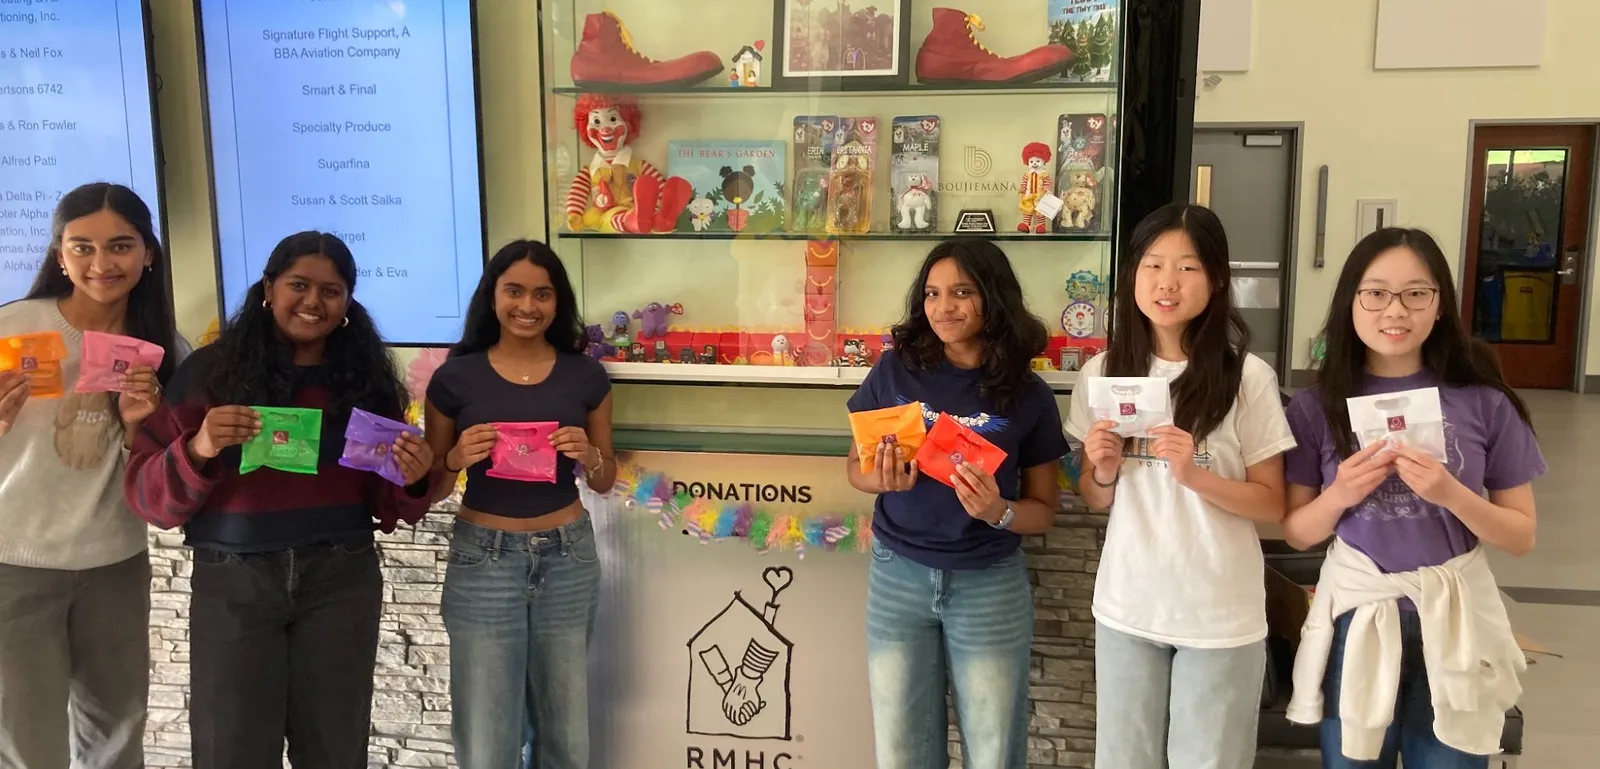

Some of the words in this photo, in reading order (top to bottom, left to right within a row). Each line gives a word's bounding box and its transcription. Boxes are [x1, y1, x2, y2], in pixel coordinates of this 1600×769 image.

[40, 11, 60, 21] Inc.
[262, 28, 315, 43] Signature
[318, 27, 349, 42] Flight
[351, 26, 399, 41] Support,
[401, 26, 411, 38] A
[9, 48, 17, 58] &
[20, 47, 40, 58] Neil
[43, 47, 63, 58] Fox
[274, 47, 299, 59] BBA
[300, 46, 344, 59] Aviation
[347, 46, 401, 59] Company
[37, 83, 64, 95] 6742
[302, 84, 335, 96] Smart
[338, 84, 347, 96] &
[349, 83, 377, 95] Final
[8, 120, 16, 131] &
[18, 119, 40, 131] Ron
[42, 119, 77, 131] Fowler
[292, 121, 342, 135] Specialty
[345, 121, 392, 133] Produce
[861, 120, 875, 133] ty
[921, 119, 936, 131] ty
[1087, 117, 1102, 130] ty
[807, 146, 825, 155] ERIN
[902, 142, 929, 152] MAPLE
[678, 149, 694, 158] THE
[699, 149, 732, 158] BEAR'S
[735, 149, 776, 158] GARDEN
[1, 155, 31, 167] Alfred
[33, 155, 57, 166] Patti
[317, 158, 371, 172] Sugarfina
[938, 182, 1017, 193] BOUJIEMANA
[6, 191, 33, 202] Delta
[35, 191, 46, 201] Pi
[291, 195, 326, 206] Susan
[328, 194, 337, 206] &
[340, 194, 368, 206] Scott
[371, 194, 403, 206] Salka
[20, 208, 49, 221] Alpha
[332, 231, 366, 244] Target
[4, 260, 33, 272] Alpha
[375, 266, 384, 278] &
[387, 266, 409, 278] Eva
[672, 480, 813, 504] DONATIONS
[687, 746, 792, 769] RMHC
